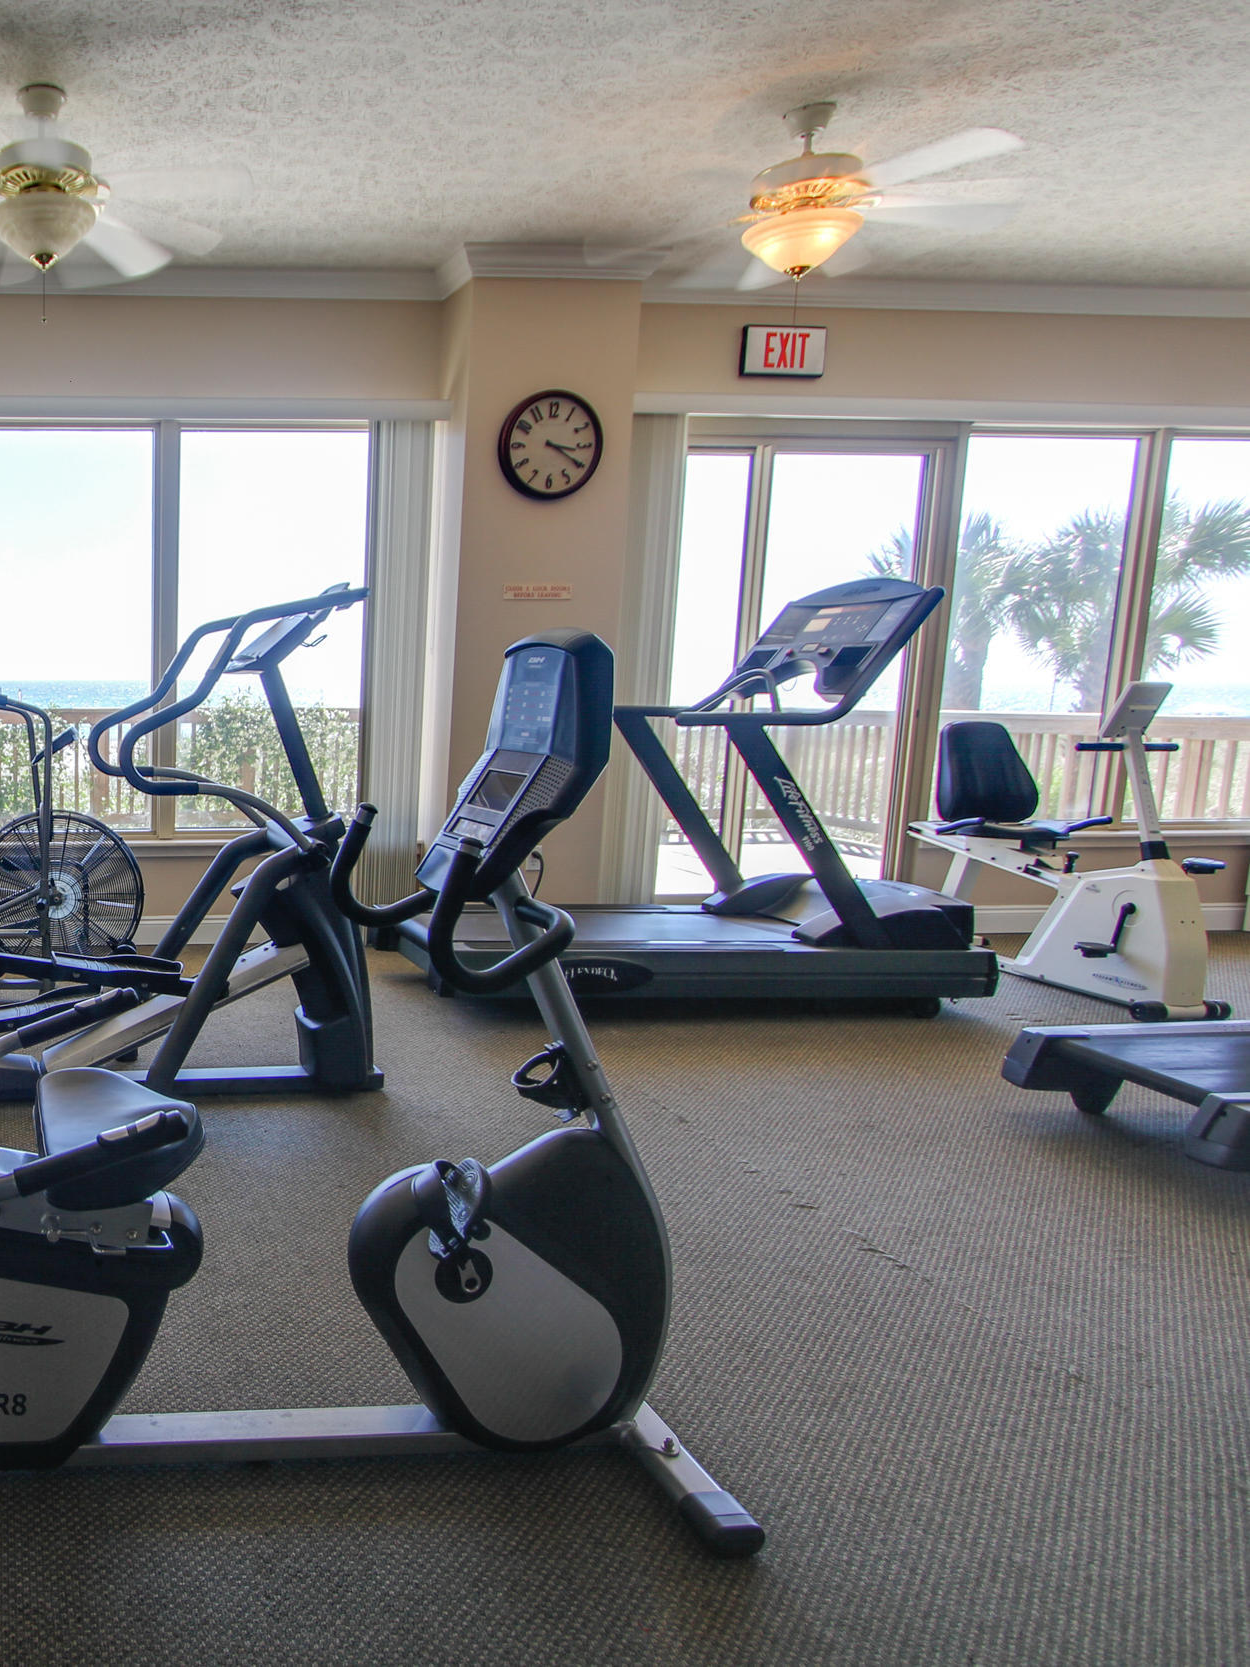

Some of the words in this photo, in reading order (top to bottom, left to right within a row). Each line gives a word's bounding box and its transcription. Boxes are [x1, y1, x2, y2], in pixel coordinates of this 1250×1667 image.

[763, 332, 810, 368] EXIT
[530, 405, 544, 423] 11
[548, 401, 560, 418] 12
[565, 406, 576, 422] 1
[516, 419, 532, 435] 10
[574, 421, 590, 434] 2
[511, 441, 526, 450] 9
[514, 458, 529, 469] 8
[527, 468, 539, 484] 7
[545, 473, 553, 489] 6
[561, 468, 571, 485] 5
